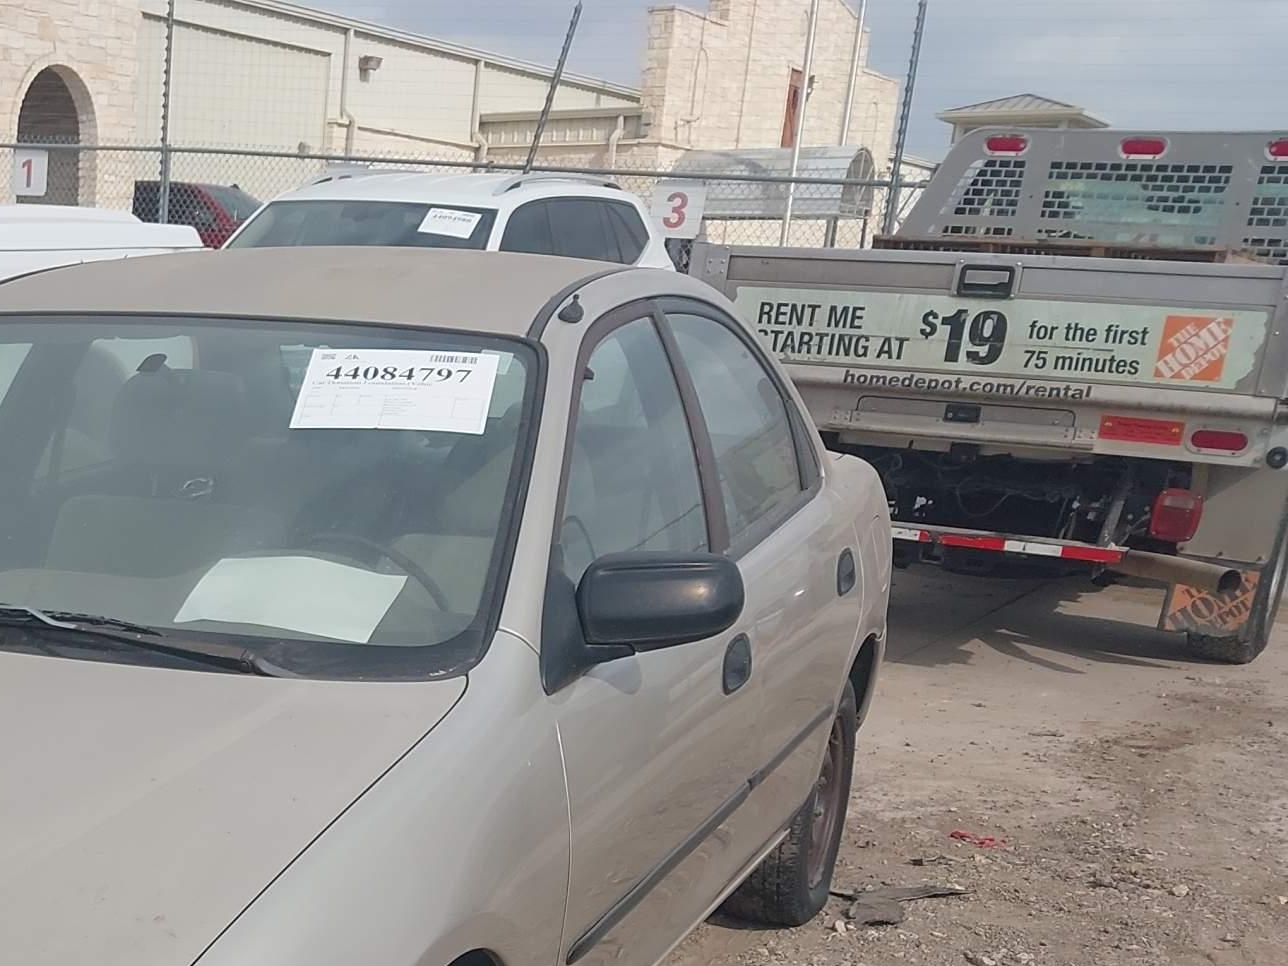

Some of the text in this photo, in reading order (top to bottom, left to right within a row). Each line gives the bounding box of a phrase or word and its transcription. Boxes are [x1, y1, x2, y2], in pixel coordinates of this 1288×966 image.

[22, 158, 33, 188] 1
[663, 191, 689, 229] 3
[757, 301, 866, 330] RENT ME
[919, 308, 1008, 366] $19
[1028, 320, 1150, 346] for the first
[1167, 322, 1198, 349] THE
[876, 336, 910, 361] AT
[1023, 349, 1140, 376] 75 minutes
[1155, 318, 1232, 379] HOME
[1181, 342, 1228, 380] DEPOT
[325, 365, 473, 384] 44084797
[843, 369, 1093, 400] homedepot.com/rental
